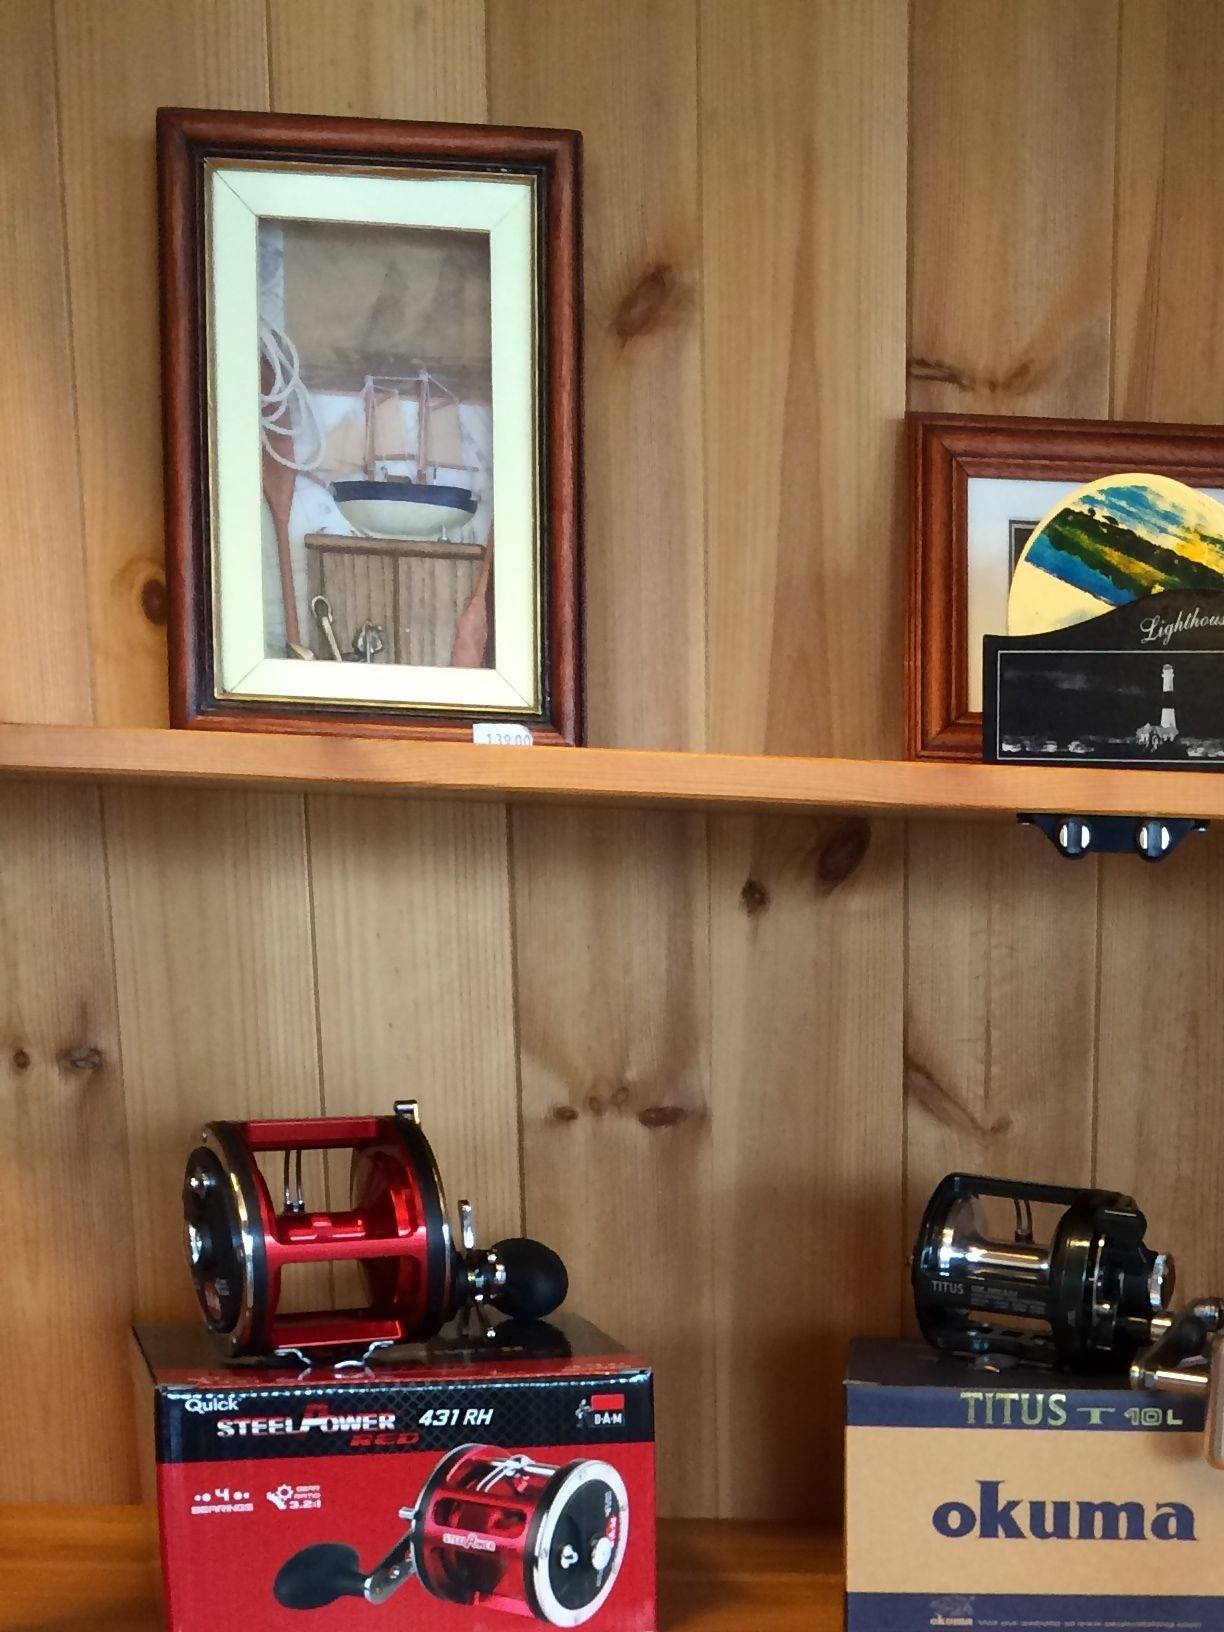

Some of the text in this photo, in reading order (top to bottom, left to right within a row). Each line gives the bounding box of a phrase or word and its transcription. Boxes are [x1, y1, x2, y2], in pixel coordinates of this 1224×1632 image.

[931, 1280, 964, 1295] TITUS
[185, 1397, 239, 1414] Quick
[960, 1392, 1067, 1426] TITUS
[1076, 1407, 1116, 1425] T
[217, 1402, 494, 1438] STEELPOWER 431 RH
[350, 1432, 420, 1447] RED
[191, 1503, 254, 1515] BEARINGS
[932, 1480, 1198, 1542] okuma
